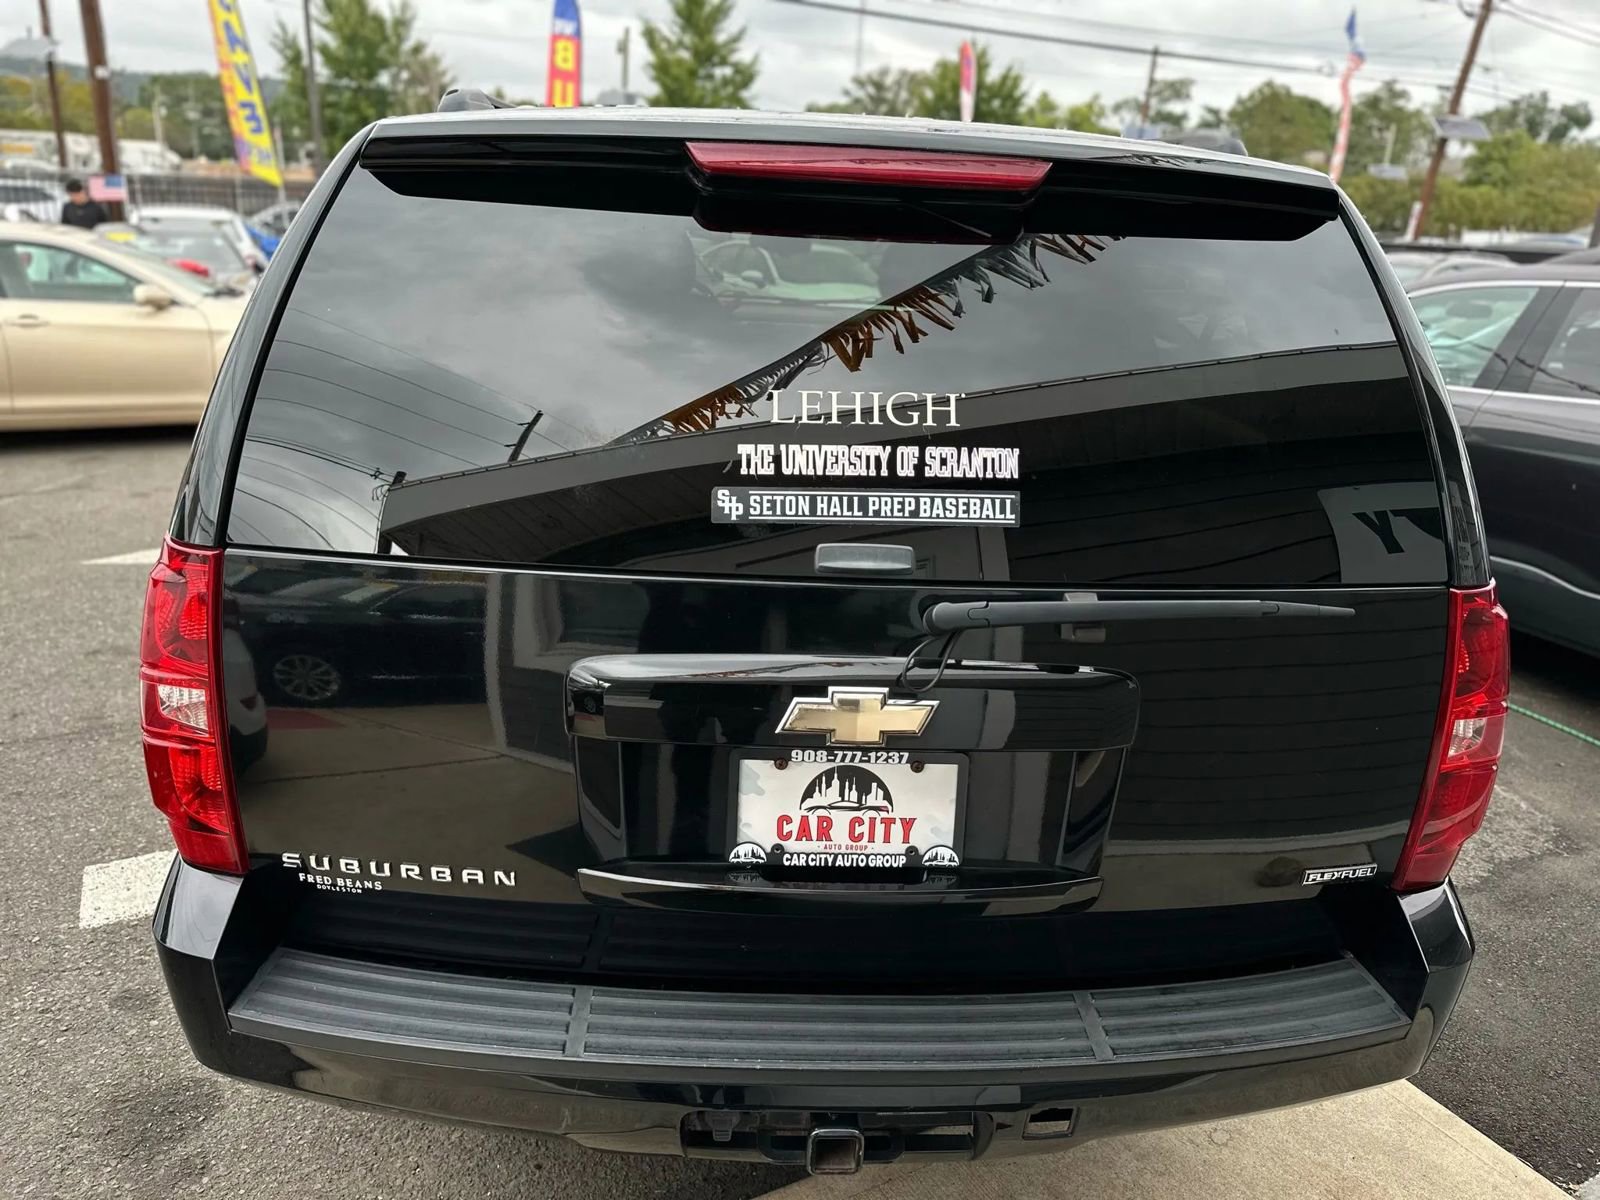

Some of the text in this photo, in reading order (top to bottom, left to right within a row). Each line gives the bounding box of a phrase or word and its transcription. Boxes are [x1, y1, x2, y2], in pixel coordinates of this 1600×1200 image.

[737, 444, 1019, 479] THE UNIVERSITY OF SCRANTON
[749, 495, 1016, 519] SETON HALL PREP BASEBALL
[791, 749, 909, 764] 908-777-1237
[776, 814, 917, 844] CAR CITY
[845, 843, 868, 851] GROUP
[281, 852, 516, 887] SUBURBAN
[783, 853, 906, 868] CAR CITY AUTO GROUP
[298, 872, 382, 890] FRED BEANS
